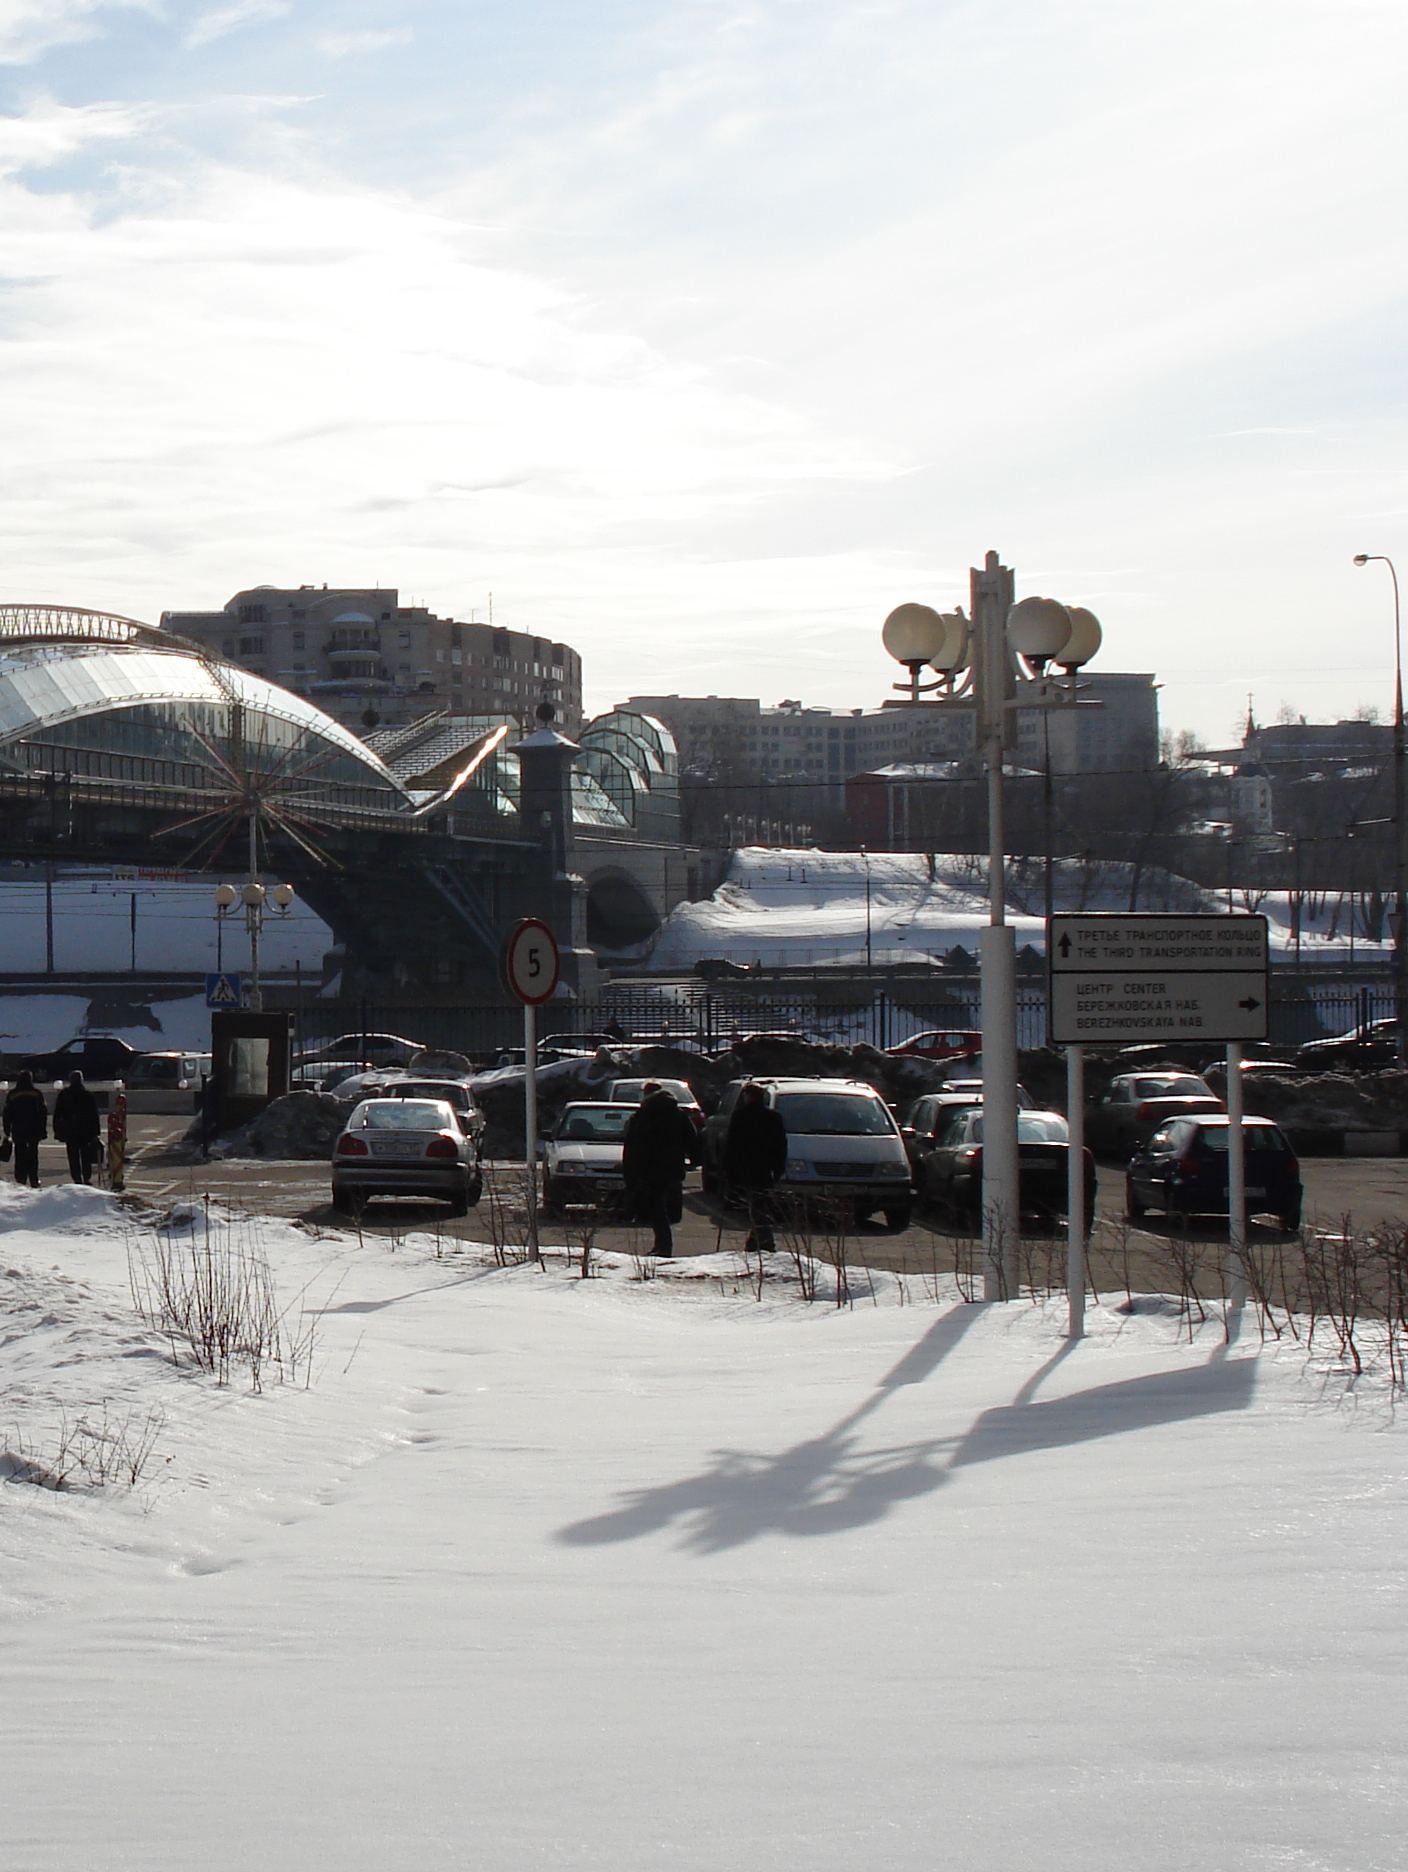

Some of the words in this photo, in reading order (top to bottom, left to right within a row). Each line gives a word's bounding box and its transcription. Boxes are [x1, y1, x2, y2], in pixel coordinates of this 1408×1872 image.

[1078, 930, 1121, 941] ТРЕТЬЕ
[1125, 930, 1213, 941] ТРАНСПОРТНОЕ
[1216, 930, 1261, 942] КОЛЬЦО
[1078, 947, 1098, 958] THE
[1103, 947, 1135, 958] THIRD
[1140, 947, 1233, 958] TRANSPORTATION
[1236, 947, 1262, 958] RING
[528, 948, 541, 978] 5
[1077, 984, 1114, 995] ЦЕНТР
[1123, 983, 1167, 994] CENTER
[1077, 1000, 1172, 1012] БЕРЕЖКОВСКАЯ
[1175, 1000, 1201, 1012] НАБ.
[1077, 1016, 1175, 1029] BEREZHKOVSKAYA
[1179, 1016, 1205, 1028] NAB.
